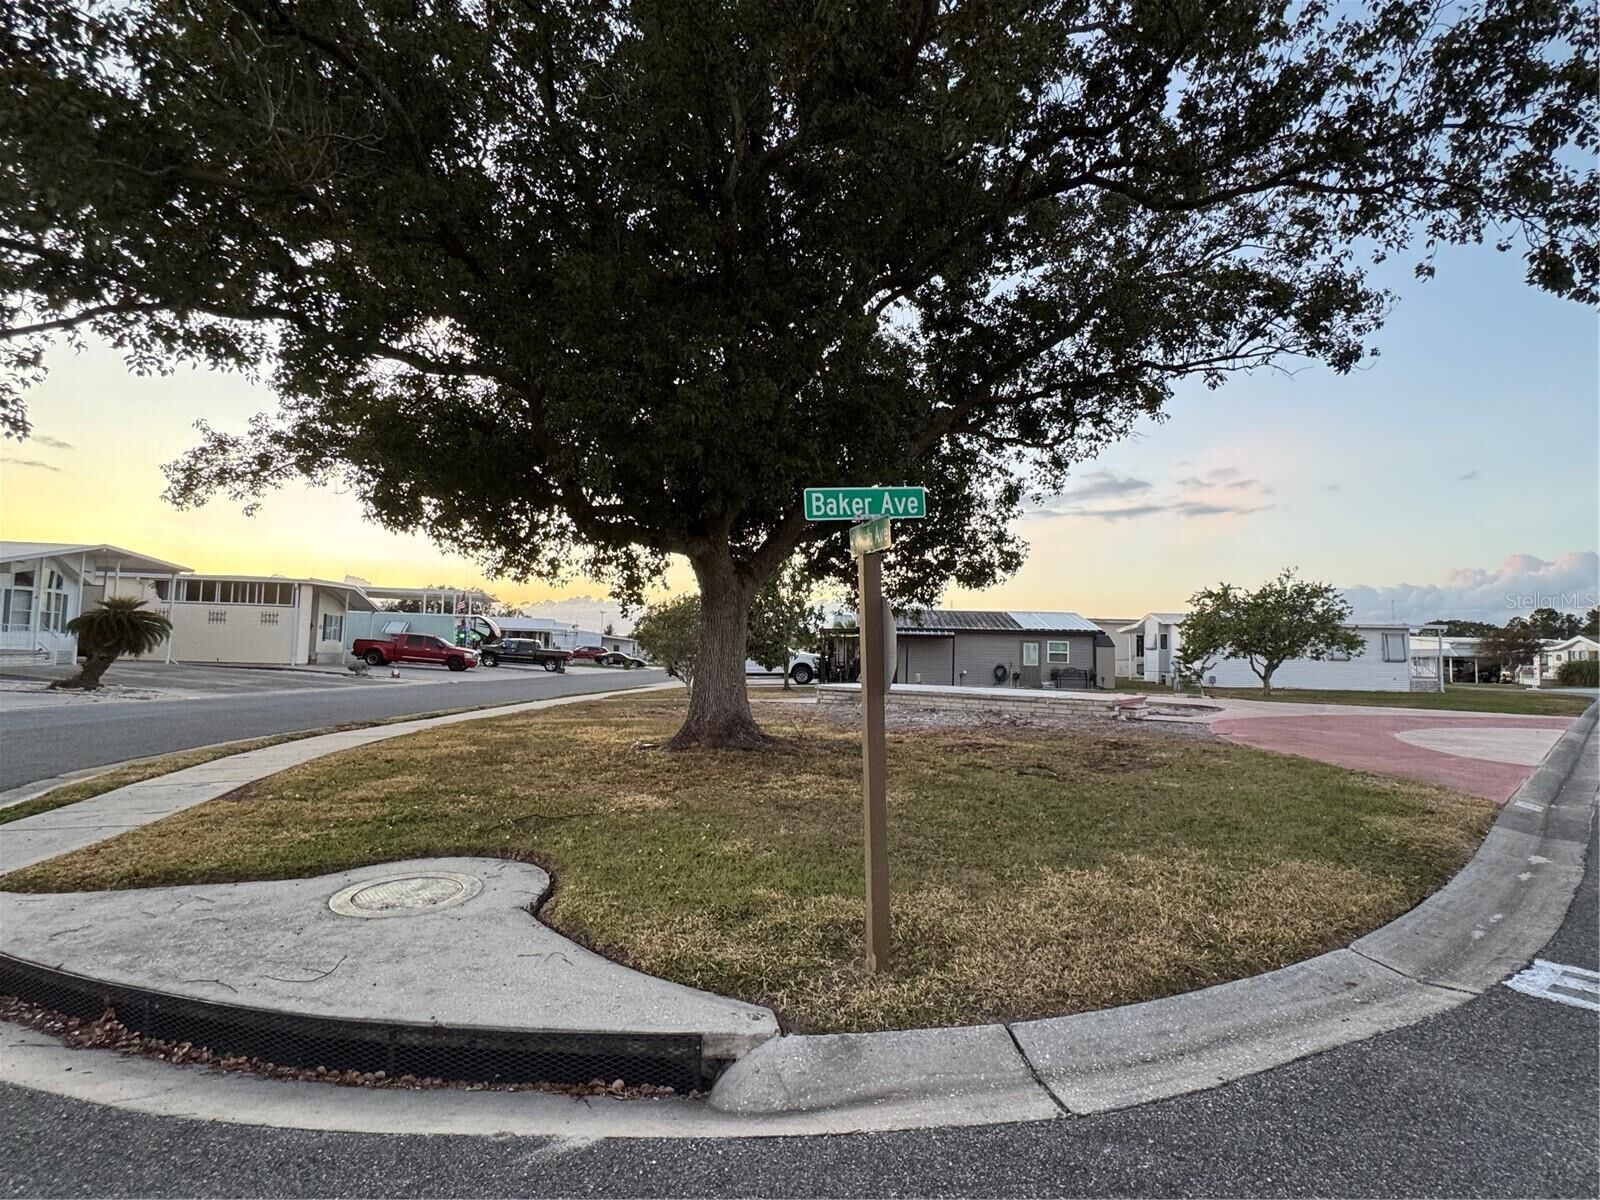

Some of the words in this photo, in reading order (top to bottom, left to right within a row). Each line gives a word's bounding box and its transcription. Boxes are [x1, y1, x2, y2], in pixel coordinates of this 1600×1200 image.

[811, 492, 872, 515] Baker
[881, 491, 919, 514] Ave
[874, 525, 889, 543] Ave
